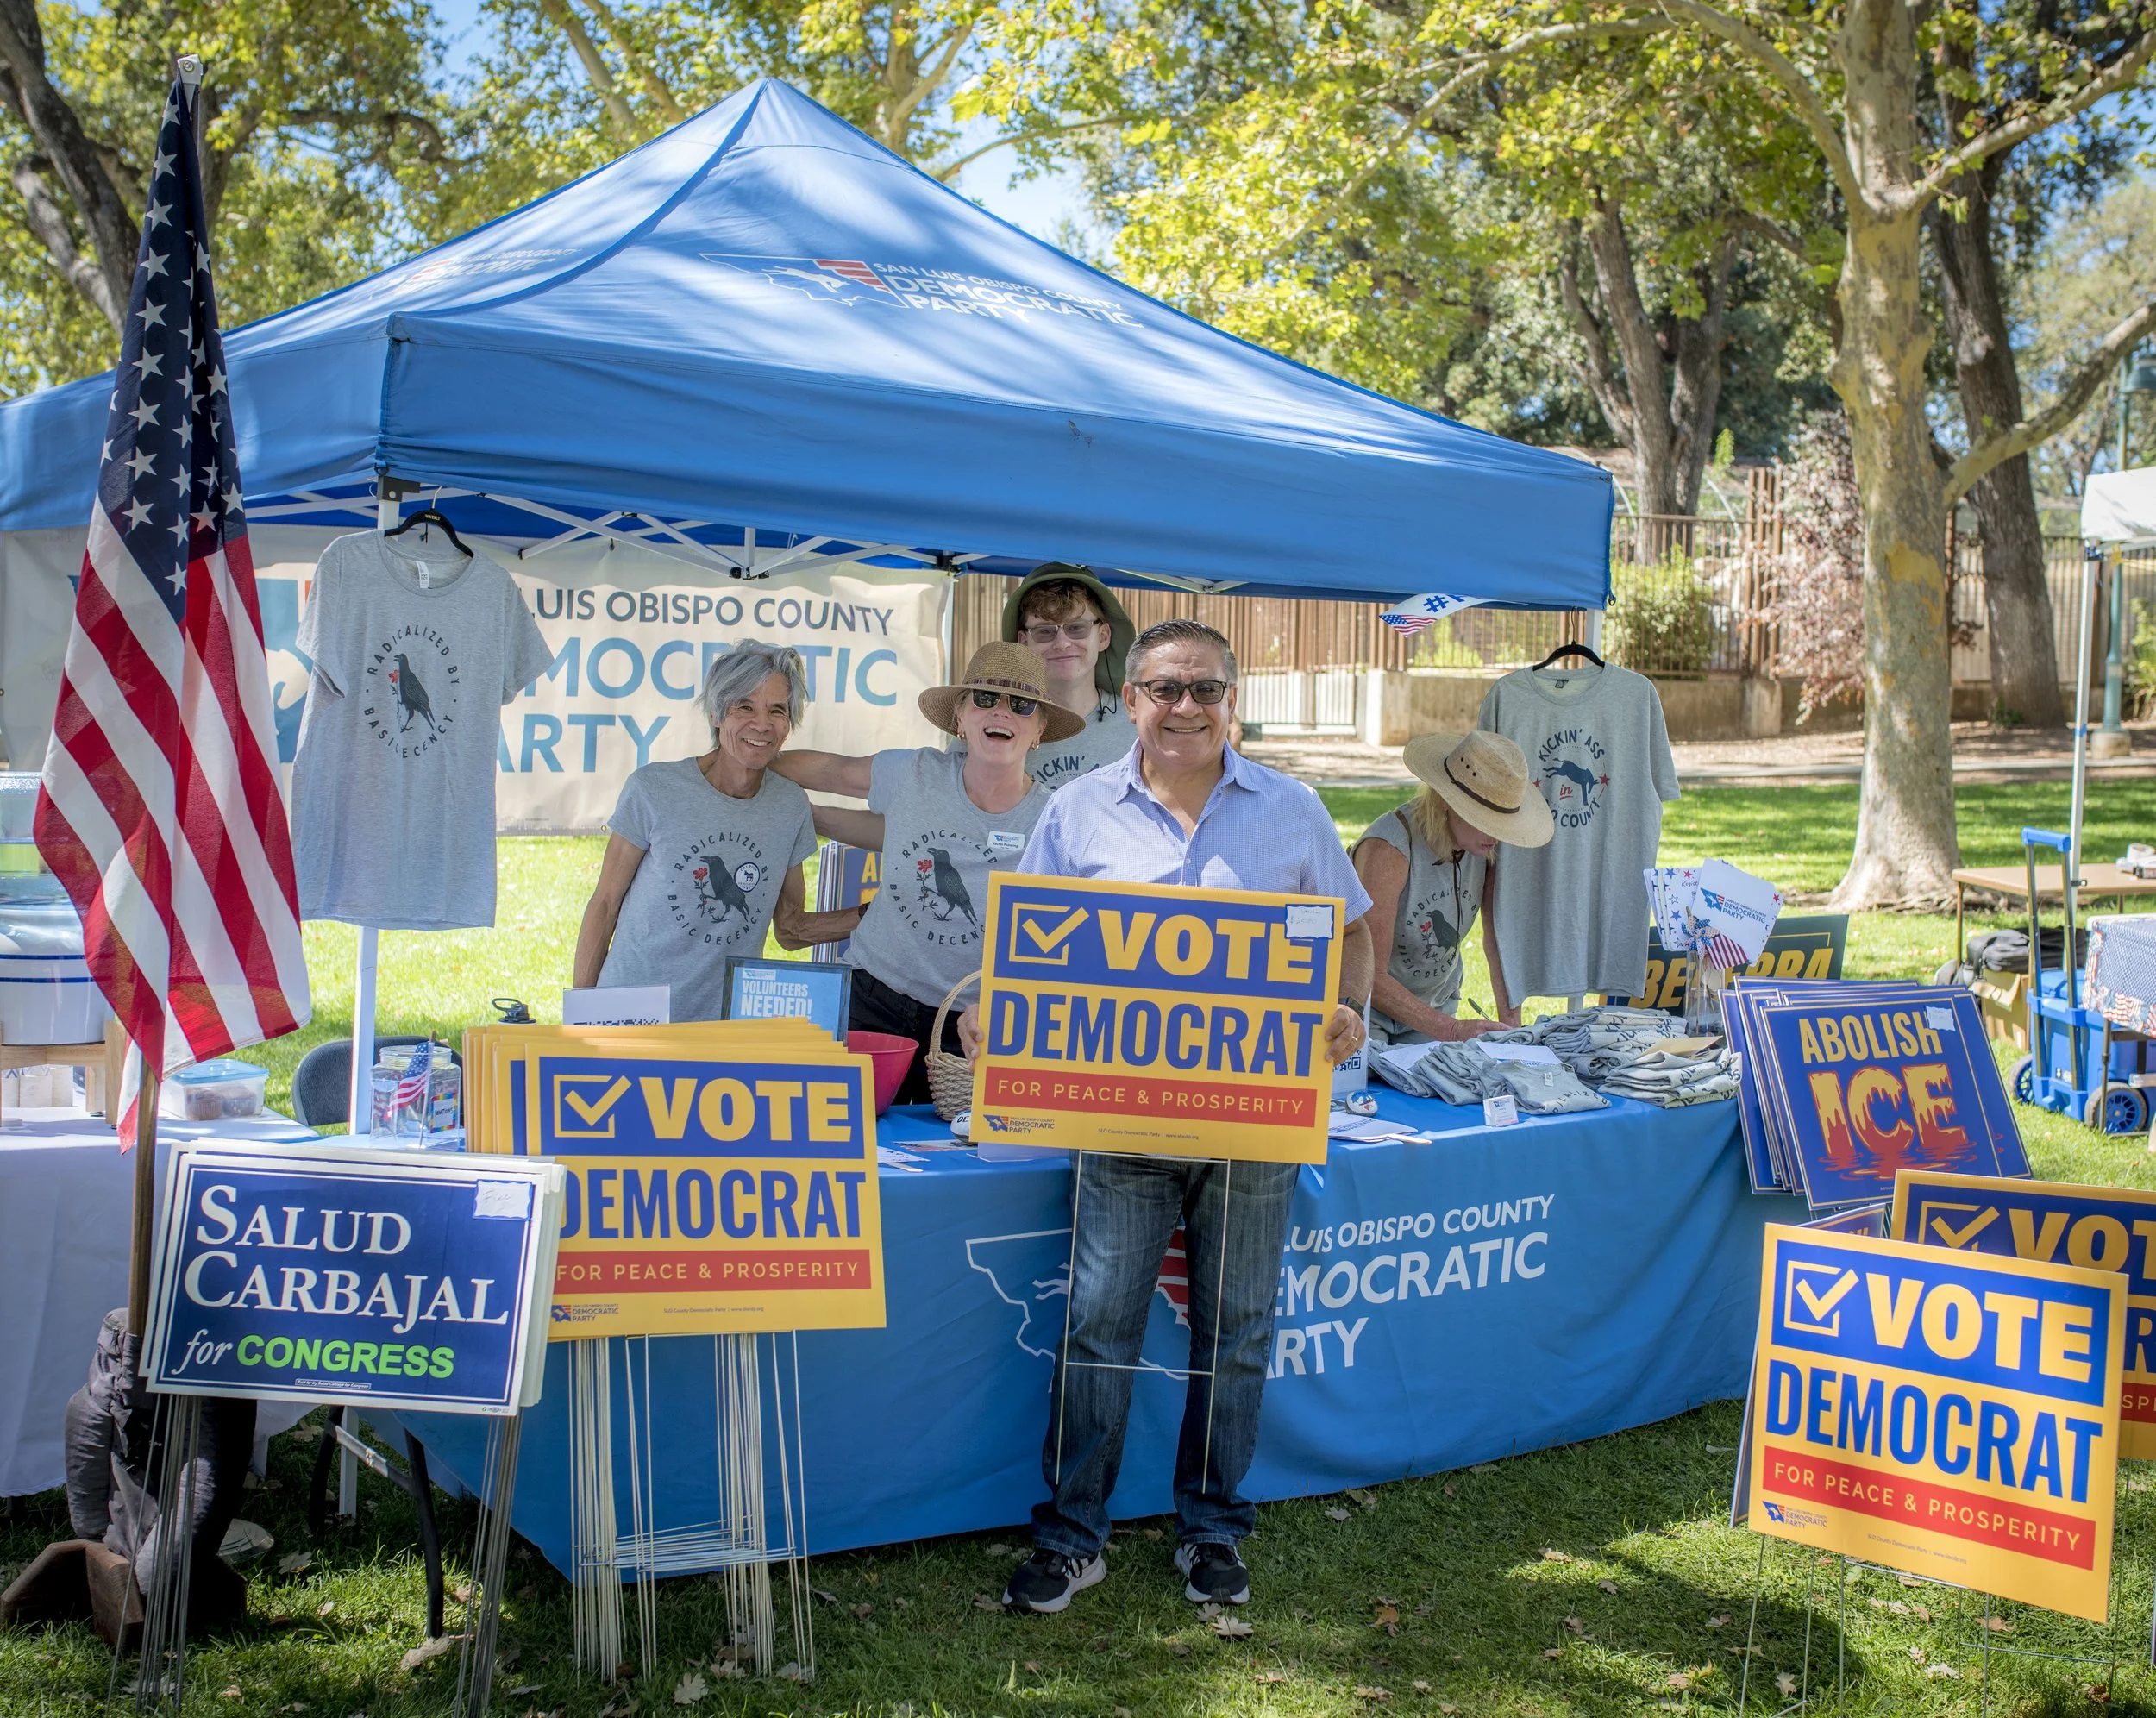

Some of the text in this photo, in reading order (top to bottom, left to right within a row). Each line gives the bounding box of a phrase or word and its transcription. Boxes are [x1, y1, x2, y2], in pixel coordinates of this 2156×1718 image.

[874, 262, 1124, 311] SAN LUIS OBISPO COUNTY
[882, 274, 1144, 329] DEMOCRATIC
[902, 293, 1031, 323] PARTY
[531, 588, 894, 636] UIS OBISPO COUNTY
[367, 624, 460, 685] RADICALIZED BY
[402, 715, 454, 759] ECENCY
[496, 713, 672, 773] RTY
[1538, 728, 1606, 762] KICKIN' ASS
[1559, 784, 1574, 797] in
[1560, 797, 1601, 828] COUNTY
[674, 831, 769, 881] RADICALIZED BY
[667, 894, 762, 945] BASIC DECENCY
[889, 883, 986, 946] BASIC DECENC
[1722, 907, 1744, 920] PARTY
[1724, 901, 1766, 924] DEMOCRATIC
[1097, 907, 1315, 985] VOTE
[740, 994, 813, 1020] NEEDED!
[742, 979, 809, 997] VOLUNTEERS
[987, 989, 1323, 1077] DEMOCRAT
[1799, 1011, 1944, 1063] ABOLISH
[639, 1076, 852, 1144] VOTE
[997, 1079, 1304, 1115] FOR PEACE & PROSPERITY
[1808, 1062, 1969, 1159] ICE
[1009, 1120, 1055, 1129] DEMOCRATIC
[196, 1184, 412, 1255] SALUD
[1337, 1213, 1436, 1249] OBISPO
[1443, 1194, 1556, 1235] COUNTY
[184, 1250, 510, 1335] CARBAJAL
[556, 1261, 860, 1282] FOR PEACE & PROSPERITY
[1275, 1232, 1549, 1317] EMOCRATIC
[1865, 1272, 2094, 1383] VOTE
[171, 1328, 455, 1379] for CONGRESS
[1764, 1358, 2103, 1504] DEMOCRAT
[1774, 1462, 2082, 1550] FOR PEACE & PROSPERITY
[1785, 1518, 1807, 1529] PARTY
[1786, 1511, 1827, 1528] DEMOCRATIC
